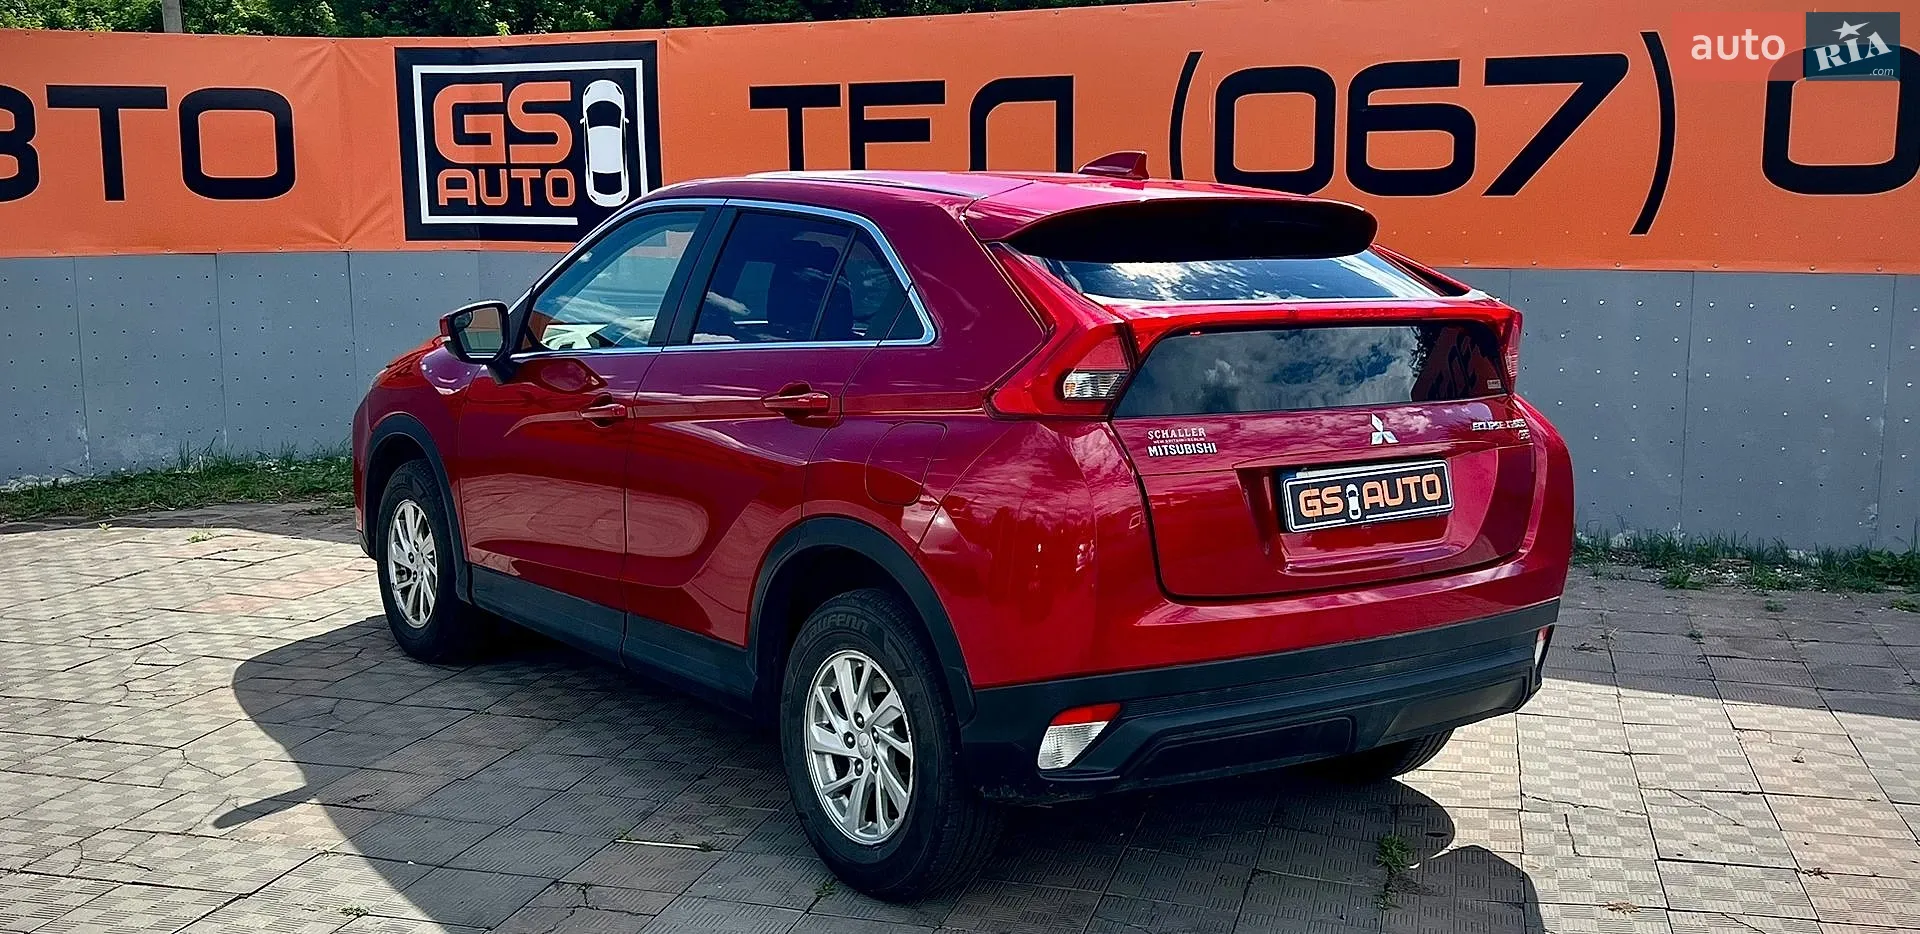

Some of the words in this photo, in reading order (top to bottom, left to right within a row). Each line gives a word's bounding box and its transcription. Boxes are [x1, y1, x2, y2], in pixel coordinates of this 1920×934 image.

[434, 81, 573, 165] GS
[750, 75, 1074, 171] ТЕЛ
[1169, 32, 1675, 235] (067)
[438, 168, 575, 207] AUTO
[1148, 427, 1206, 440] SCHALLER
[1148, 442, 1218, 457] MITSUBISHI
[1298, 488, 1344, 518] GS
[1363, 474, 1441, 510] AUTO
